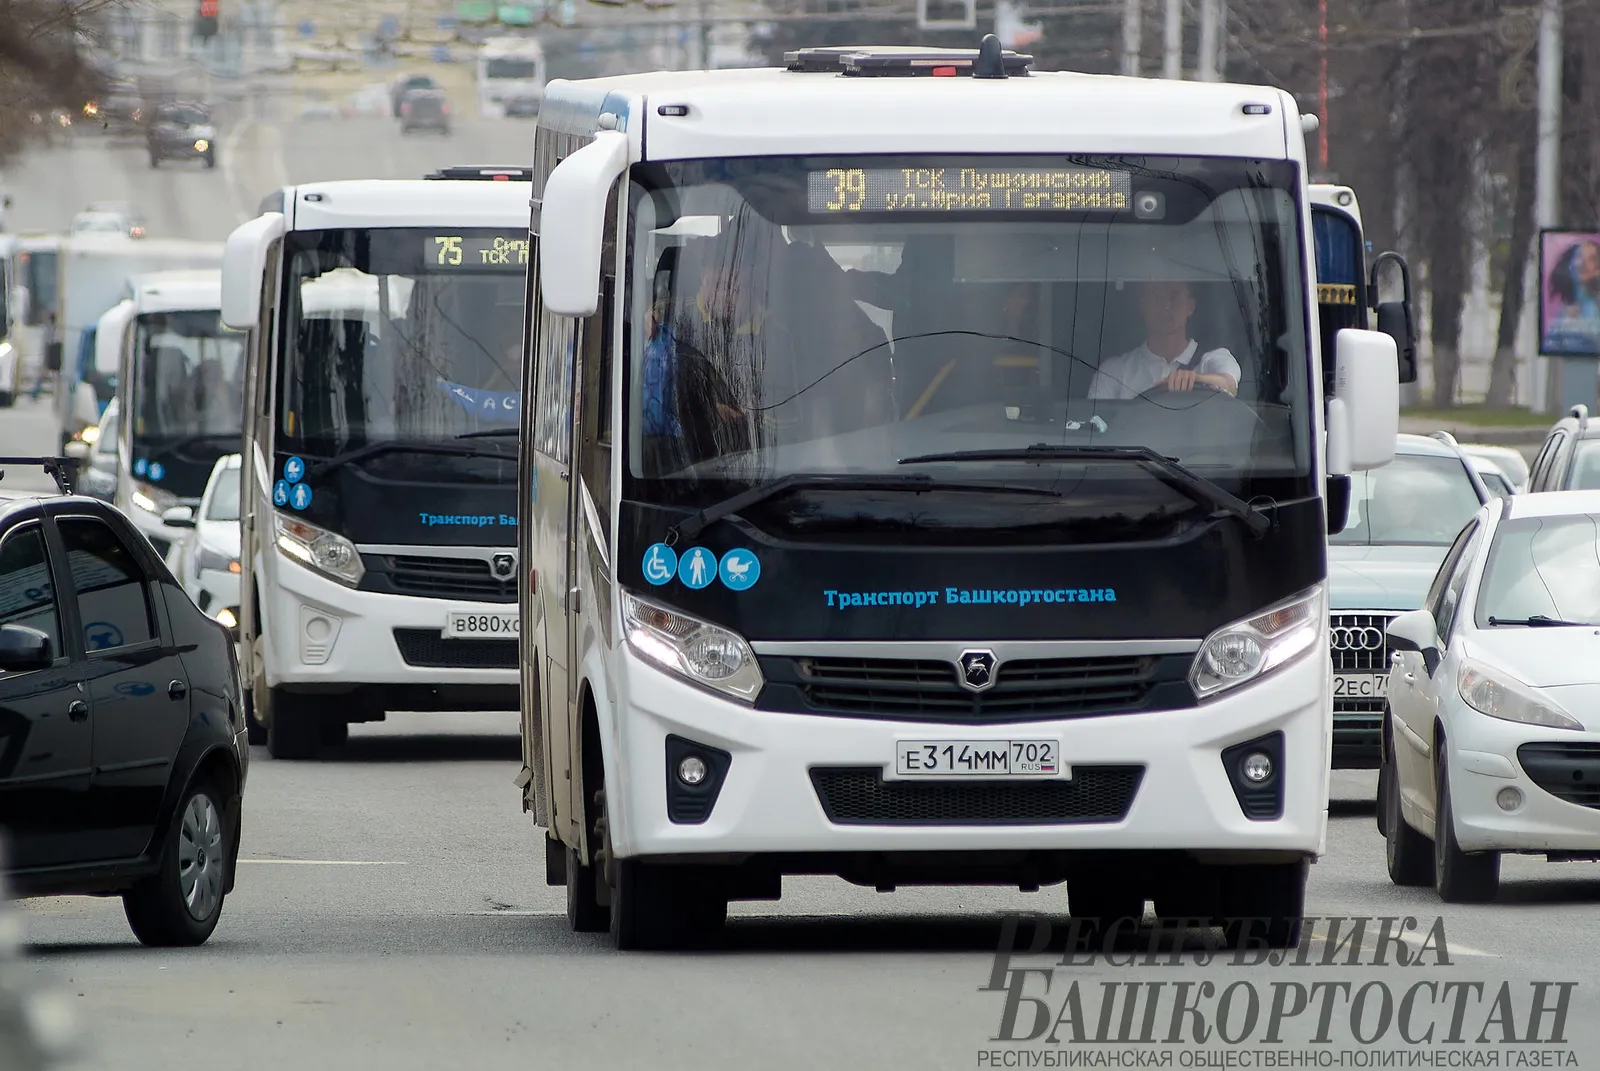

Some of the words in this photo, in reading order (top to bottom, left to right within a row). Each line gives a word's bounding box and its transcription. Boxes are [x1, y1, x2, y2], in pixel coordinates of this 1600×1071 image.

[826, 168, 866, 211] 39
[901, 168, 945, 188] ТСК
[960, 168, 1111, 190] Пушкинский
[1005, 188, 1126, 210] Гагарина
[434, 236, 463, 265] 75
[479, 249, 510, 264] ТСК
[419, 513, 496, 528] Транспорт
[499, 514, 519, 526] Ба
[824, 589, 939, 610] Транспорт
[945, 587, 1117, 607] Башкортостана
[906, 745, 1008, 770] Е314ММ
[1013, 743, 1051, 762] 702
[1021, 763, 1041, 771] RUS
